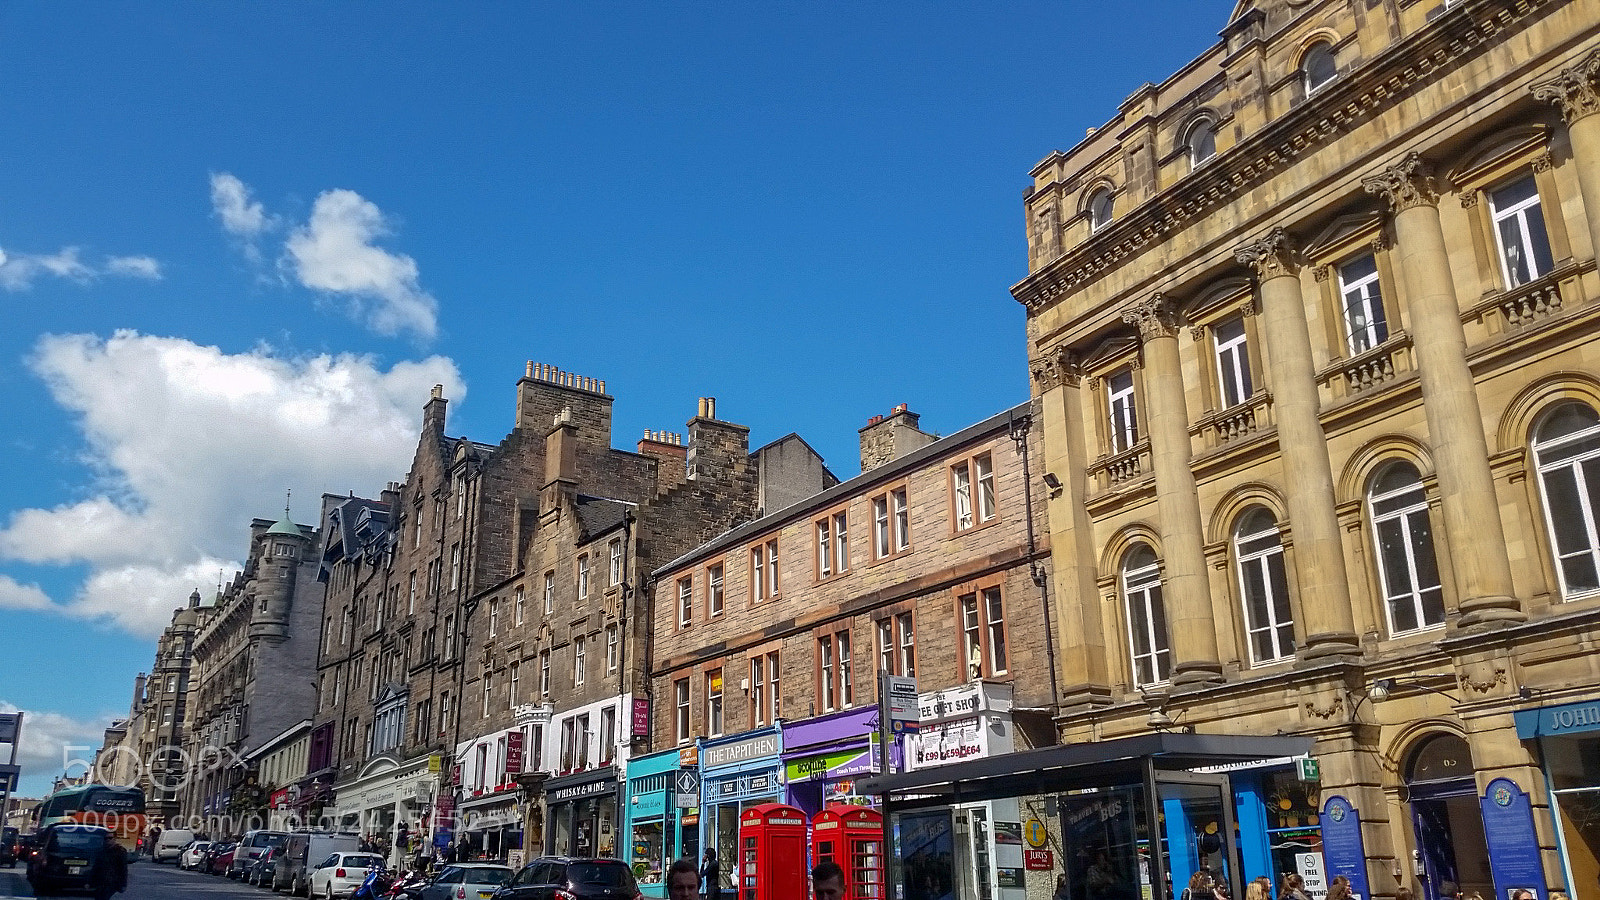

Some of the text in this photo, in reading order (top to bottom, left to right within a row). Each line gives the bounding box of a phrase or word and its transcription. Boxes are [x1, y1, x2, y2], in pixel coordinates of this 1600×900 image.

[918, 696, 981, 718] EE GIFT SHOP
[709, 748, 724, 764] THE
[724, 742, 752, 759] TAPPIT
[754, 738, 775, 755] HEN
[925, 751, 939, 762] £99
[555, 781, 605, 800] WHISKY & WINE
[1101, 800, 1122, 822] BUS
[1029, 850, 1048, 860] JURYS
[1305, 879, 1321, 887] STOP
[1313, 889, 1328, 897] KING
